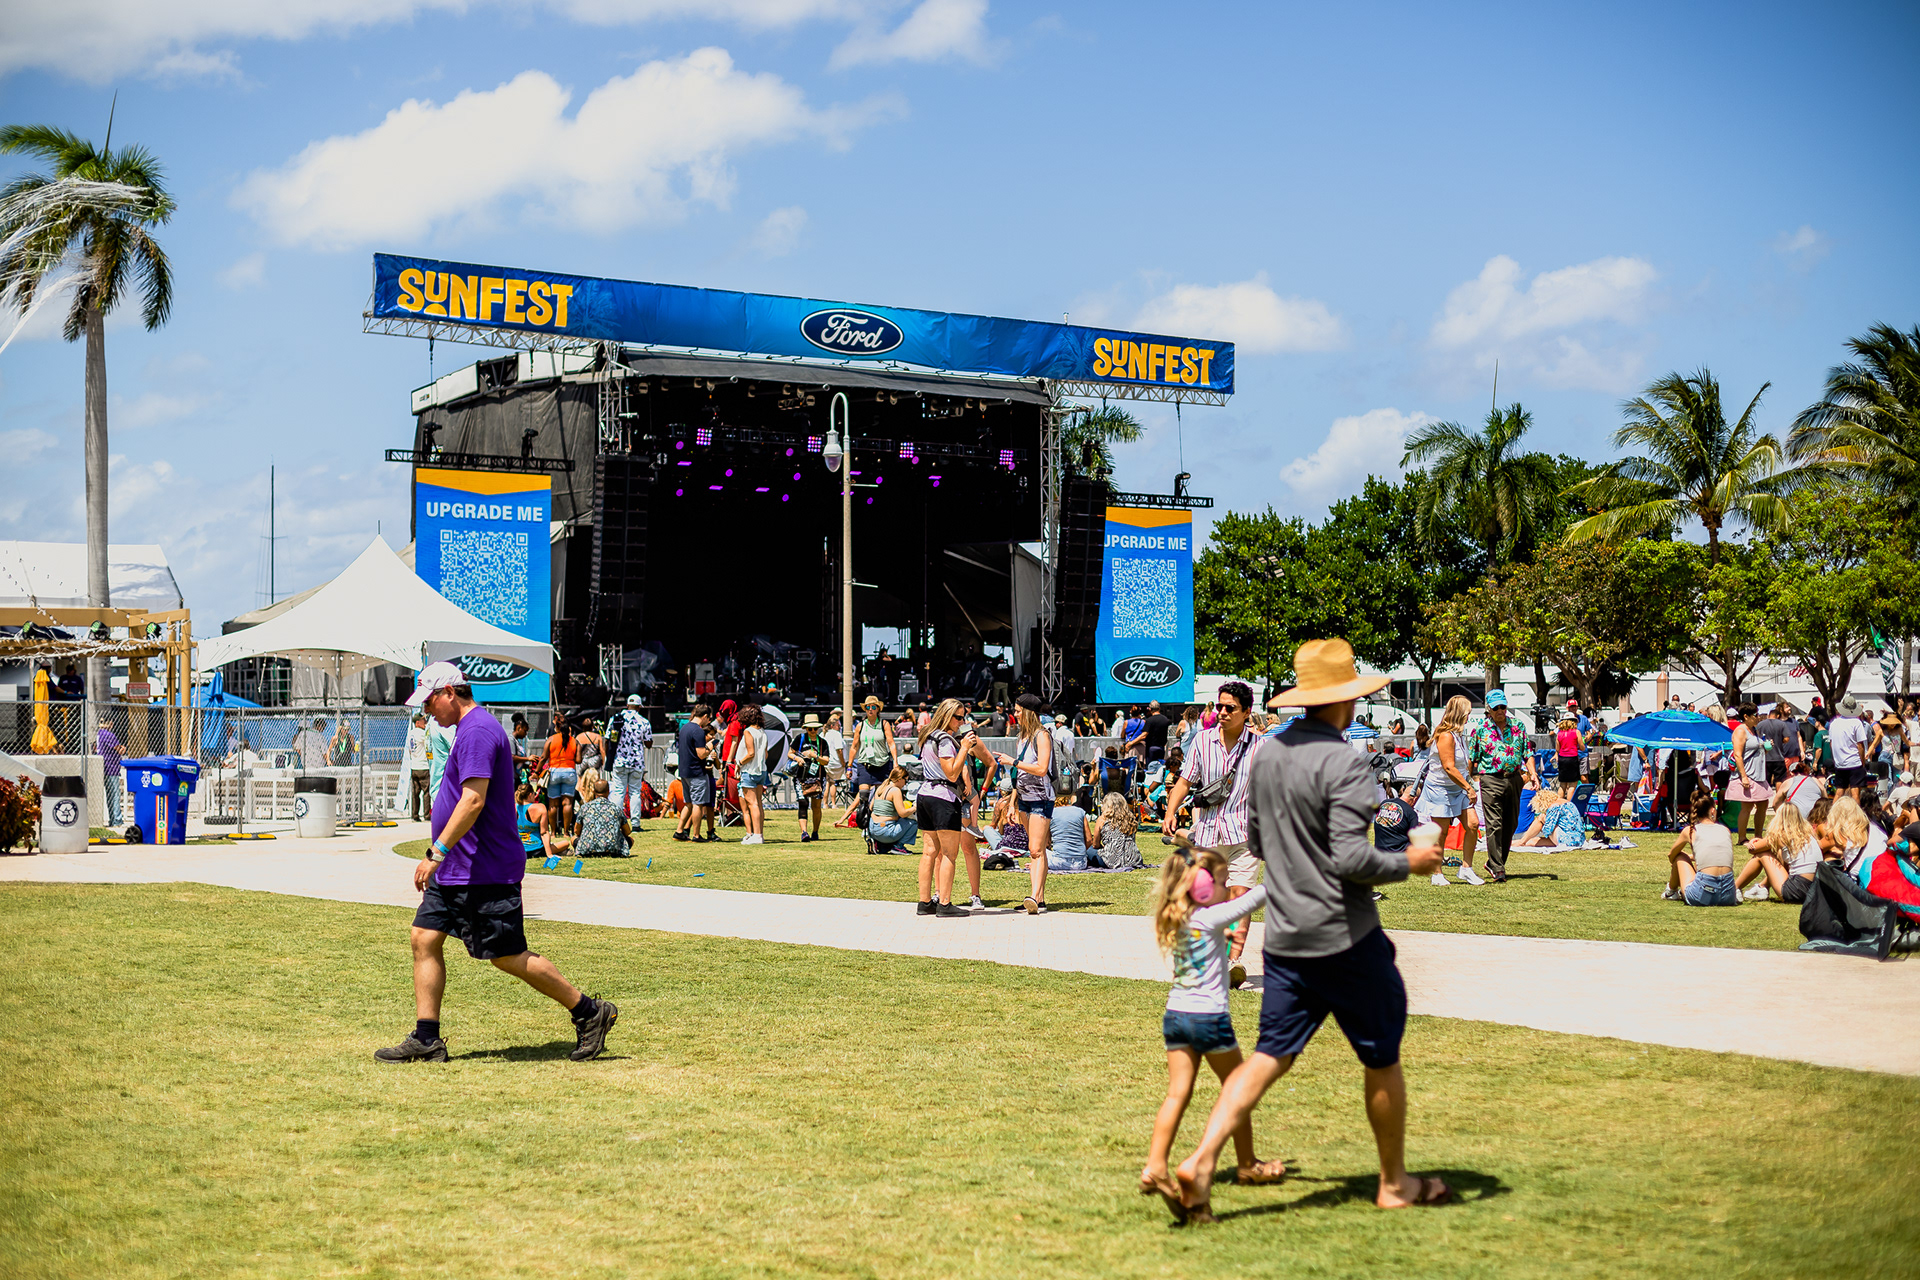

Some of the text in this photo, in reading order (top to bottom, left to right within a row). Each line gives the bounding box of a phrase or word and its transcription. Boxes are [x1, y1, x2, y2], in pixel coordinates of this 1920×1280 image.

[397, 267, 574, 328] SUNFEST
[820, 314, 884, 349] Ford
[1093, 337, 1216, 386] SUNFEST
[426, 501, 543, 522] UPGRADE ME
[1168, 536, 1187, 551] ME
[1125, 660, 1169, 684] Ford
